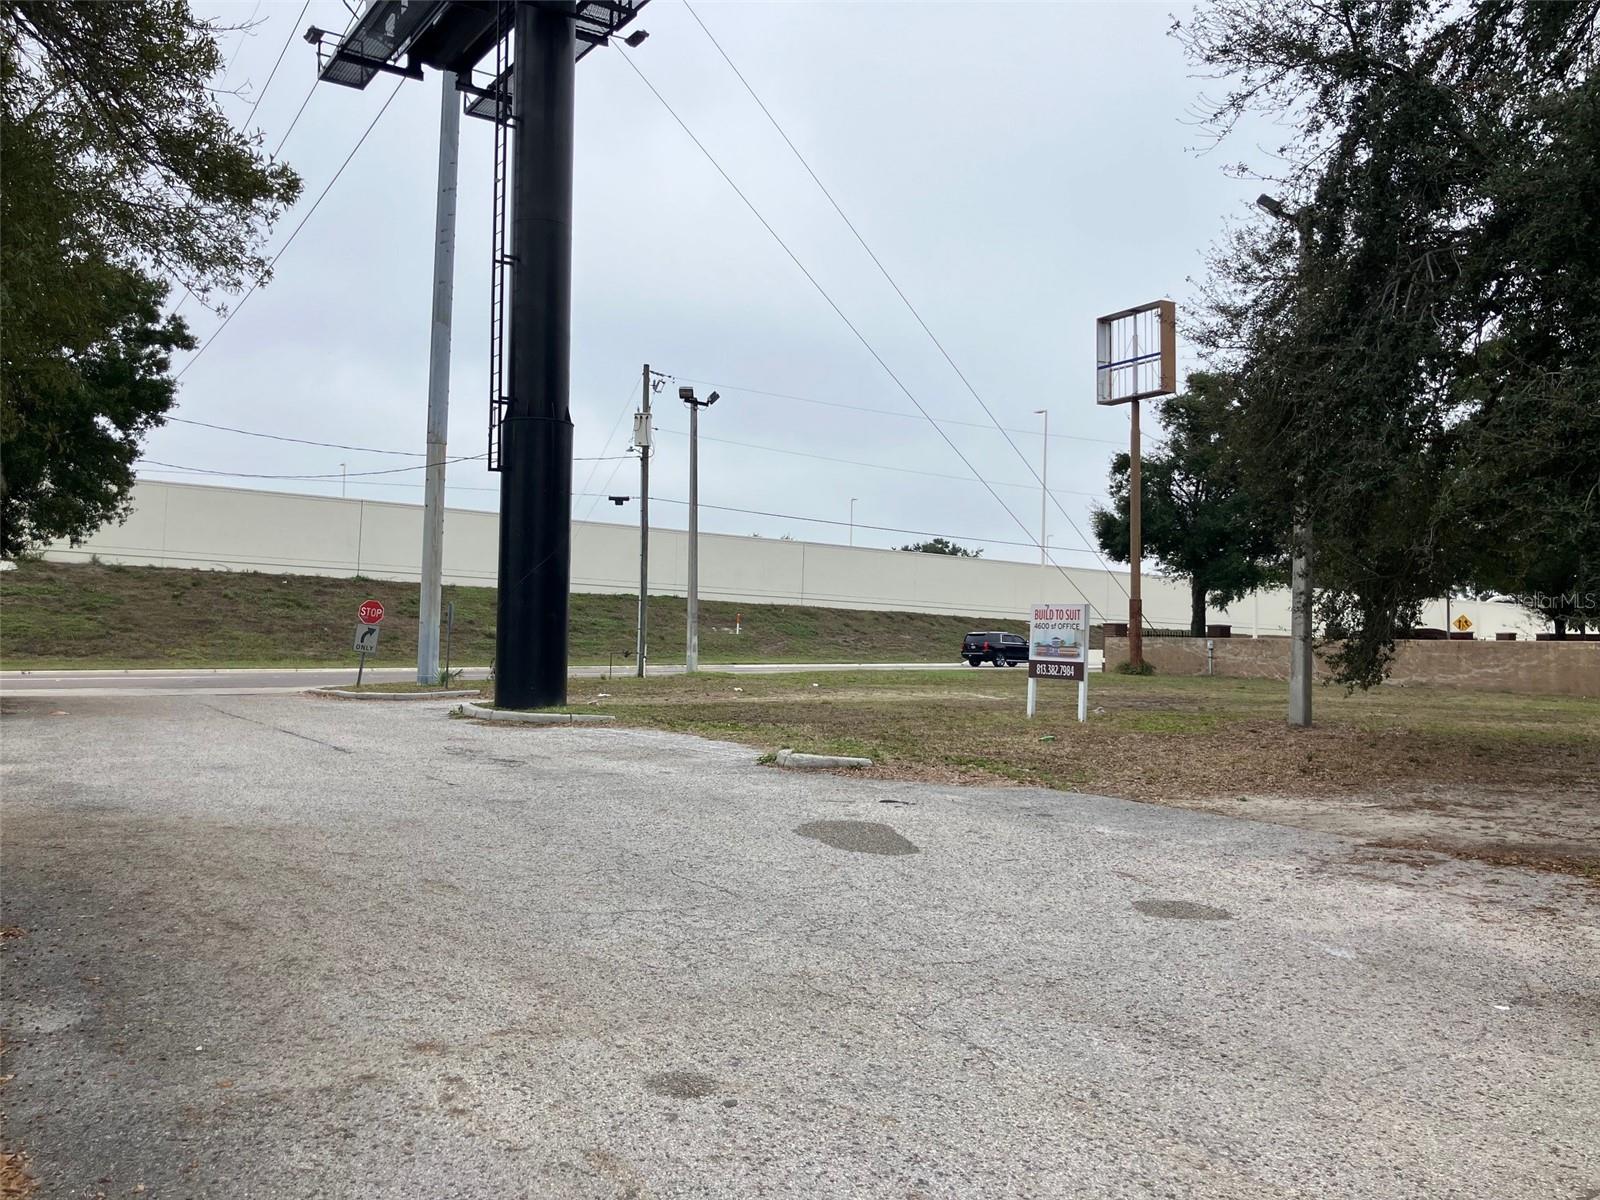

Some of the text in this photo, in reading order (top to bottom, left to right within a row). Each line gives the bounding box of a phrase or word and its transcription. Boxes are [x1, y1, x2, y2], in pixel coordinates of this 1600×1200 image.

[360, 607, 382, 617] STOP
[1034, 609, 1081, 620] BUILD TO SUIT
[1034, 622, 1050, 630] 4600
[1057, 622, 1080, 630] OFFICE
[355, 643, 373, 651] ONLY
[1036, 663, 1075, 677] 813.382.7984
